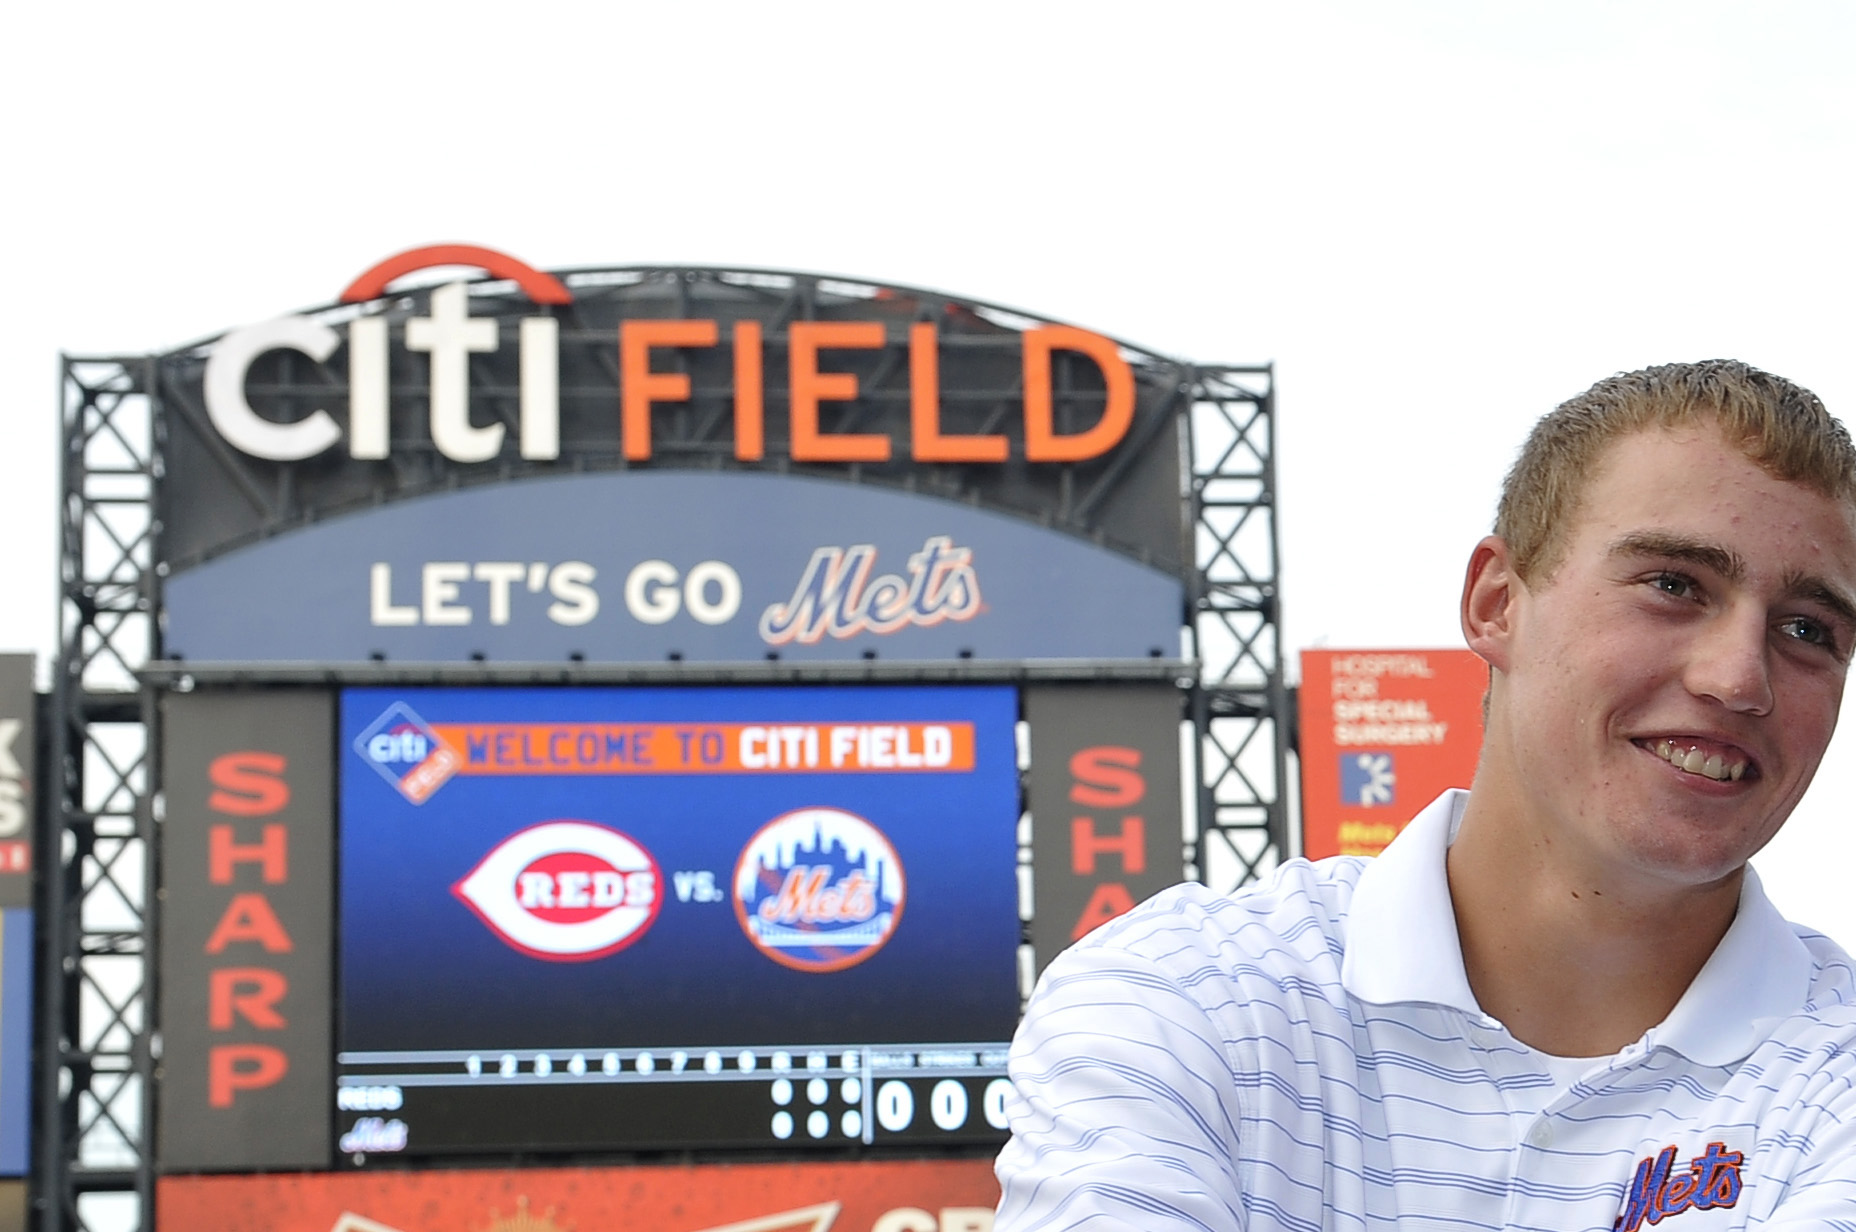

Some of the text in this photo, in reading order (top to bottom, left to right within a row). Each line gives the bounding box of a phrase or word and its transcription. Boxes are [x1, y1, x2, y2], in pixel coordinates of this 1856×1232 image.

[620, 320, 1136, 463] FIELD
[370, 534, 989, 646] LET'S GO Mets
[465, 730, 654, 768] WELCOME
[675, 730, 724, 766] TO
[739, 727, 819, 768] CITI
[829, 726, 953, 768] FIELD
[206, 751, 293, 1108] SHARP
[520, 864, 876, 925] REDS VS. Mets
[876, 1079, 915, 1132] 0
[930, 1078, 969, 1131] 0
